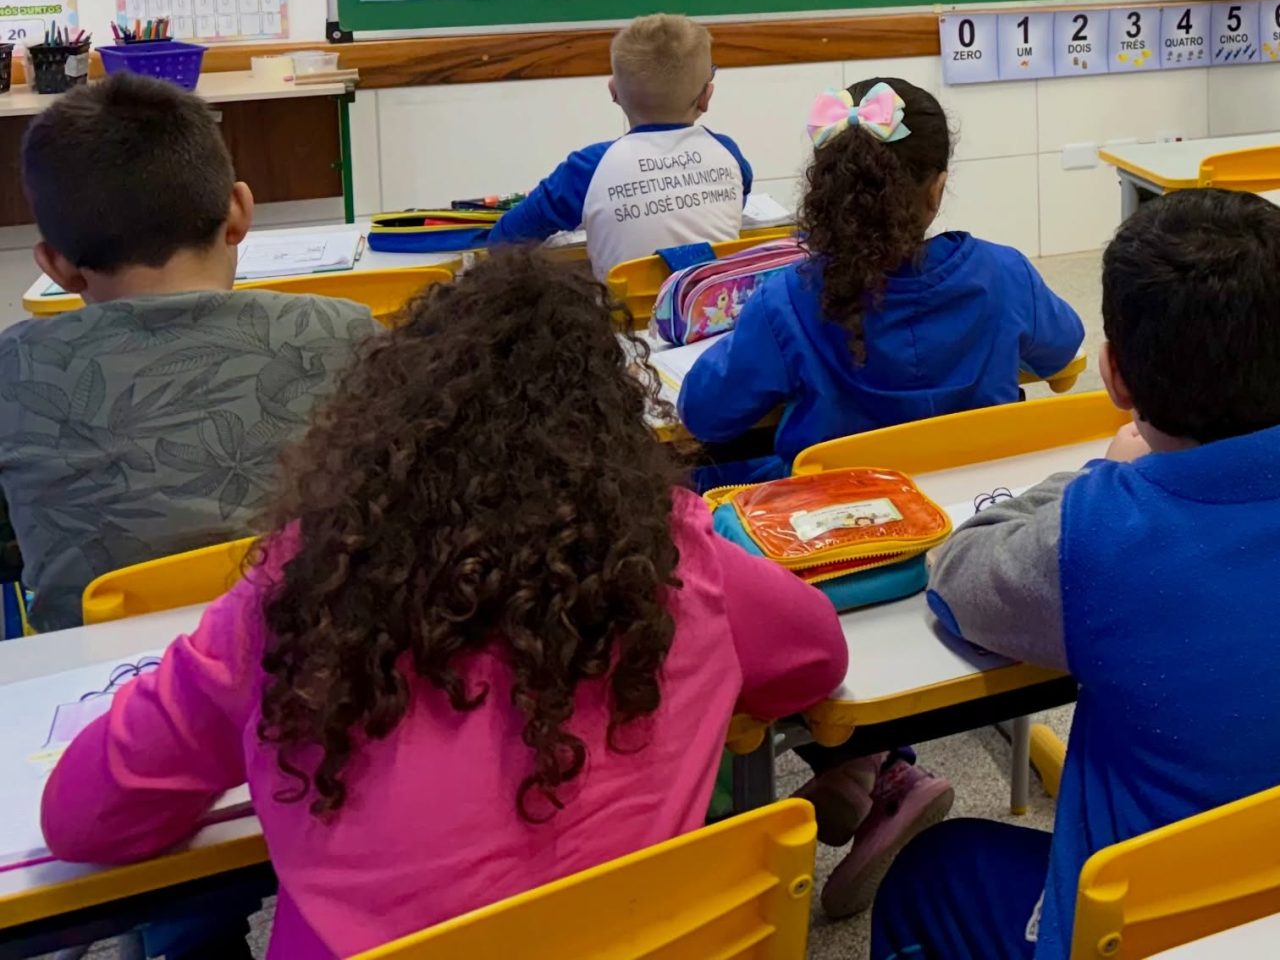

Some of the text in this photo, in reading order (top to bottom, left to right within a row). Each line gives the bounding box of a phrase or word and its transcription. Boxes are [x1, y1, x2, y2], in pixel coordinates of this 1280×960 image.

[1017, 16, 1029, 44] 1
[1071, 14, 1088, 41] 2
[1125, 11, 1141, 38] 3
[1176, 8, 1193, 35] 4
[1226, 6, 1242, 32] 5
[958, 19, 975, 48] 0
[1165, 36, 1204, 48] QUATRO
[1220, 33, 1248, 44] CINCO
[953, 50, 982, 61] ZERO
[1017, 47, 1033, 57] UM
[1068, 43, 1092, 54] DOIS
[638, 151, 702, 172] EDUCAÇÃO
[608, 167, 735, 201] PREFEITURA MUNICIPAL
[614, 187, 737, 222] SÃO JOSÉ DOS PINHAIS
